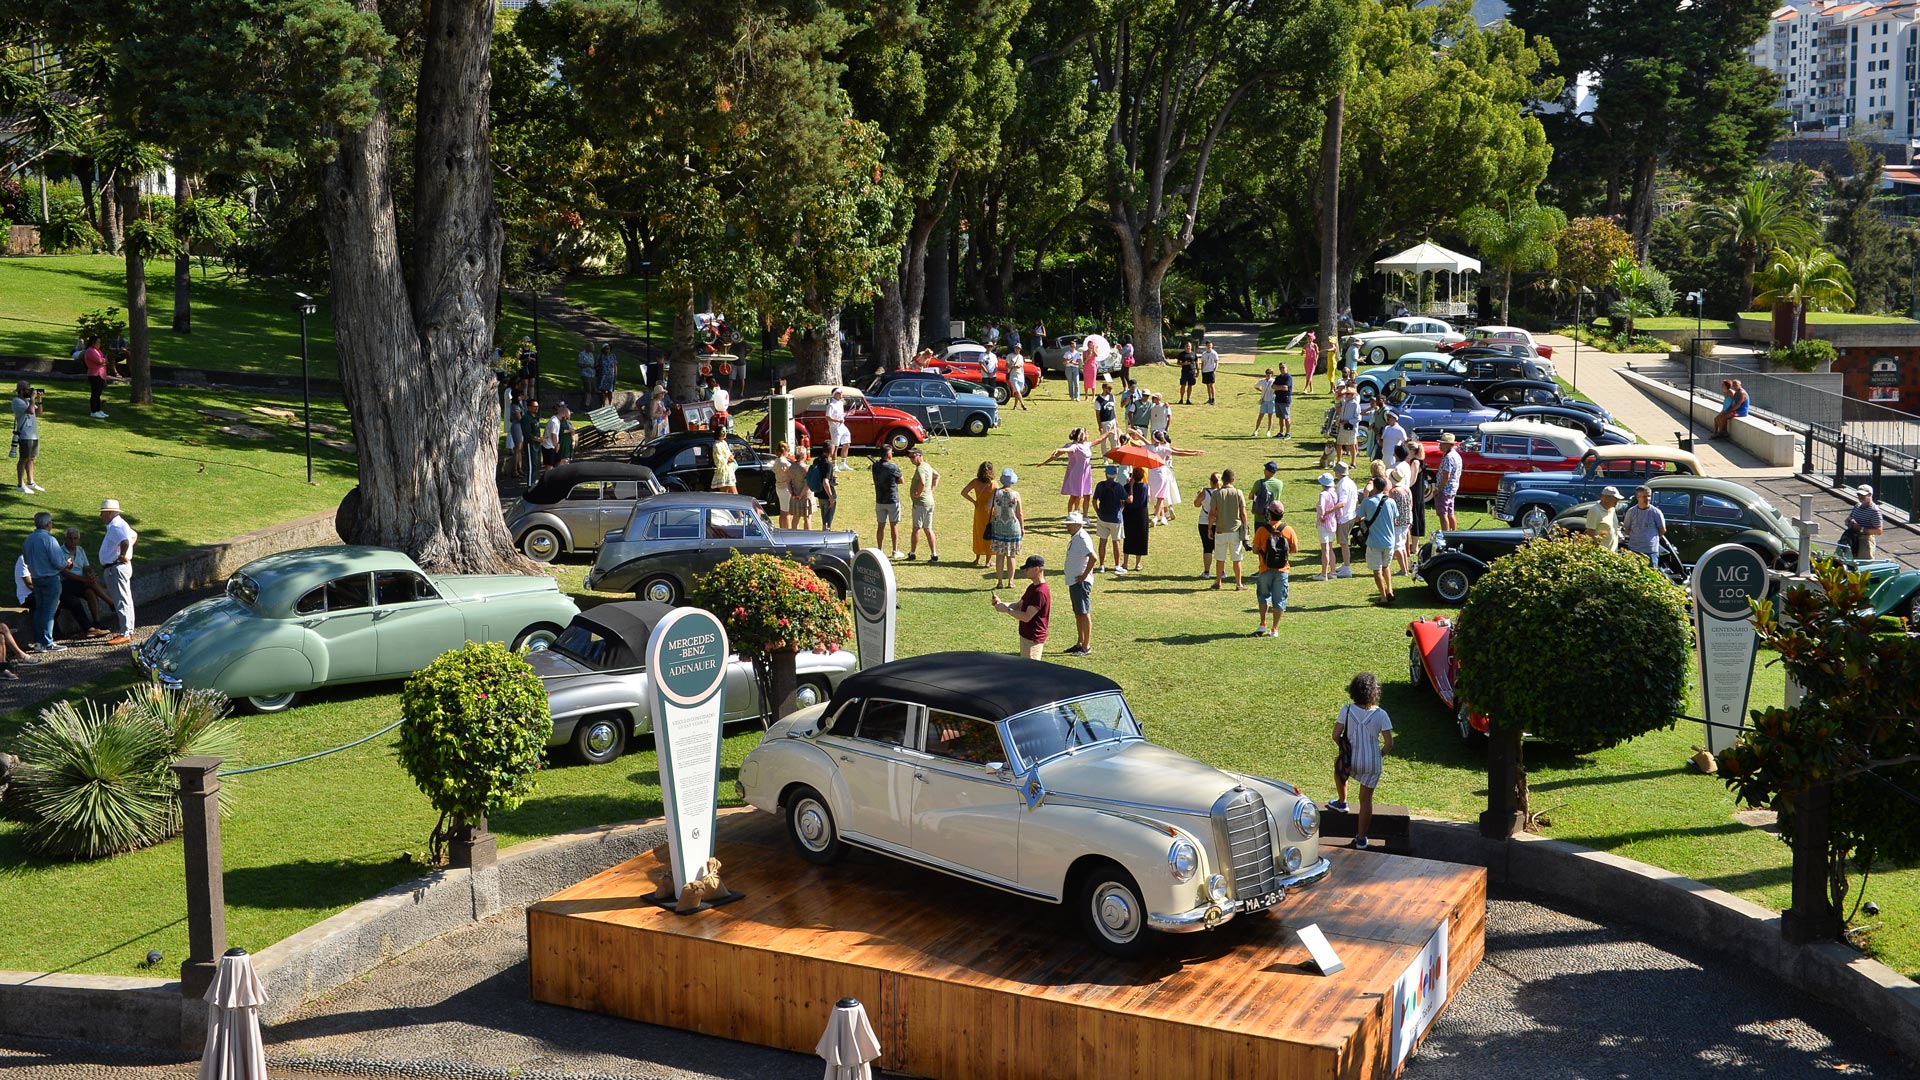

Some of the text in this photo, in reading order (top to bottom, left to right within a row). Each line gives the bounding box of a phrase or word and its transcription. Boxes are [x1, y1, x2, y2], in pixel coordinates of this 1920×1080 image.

[1716, 566, 1749, 582] MG
[864, 587, 876, 598] 100
[1718, 588, 1744, 598] 100
[668, 634, 715, 650] MERCEDES
[679, 646, 706, 658] -BENZ
[668, 660, 716, 676] ADENAUER
